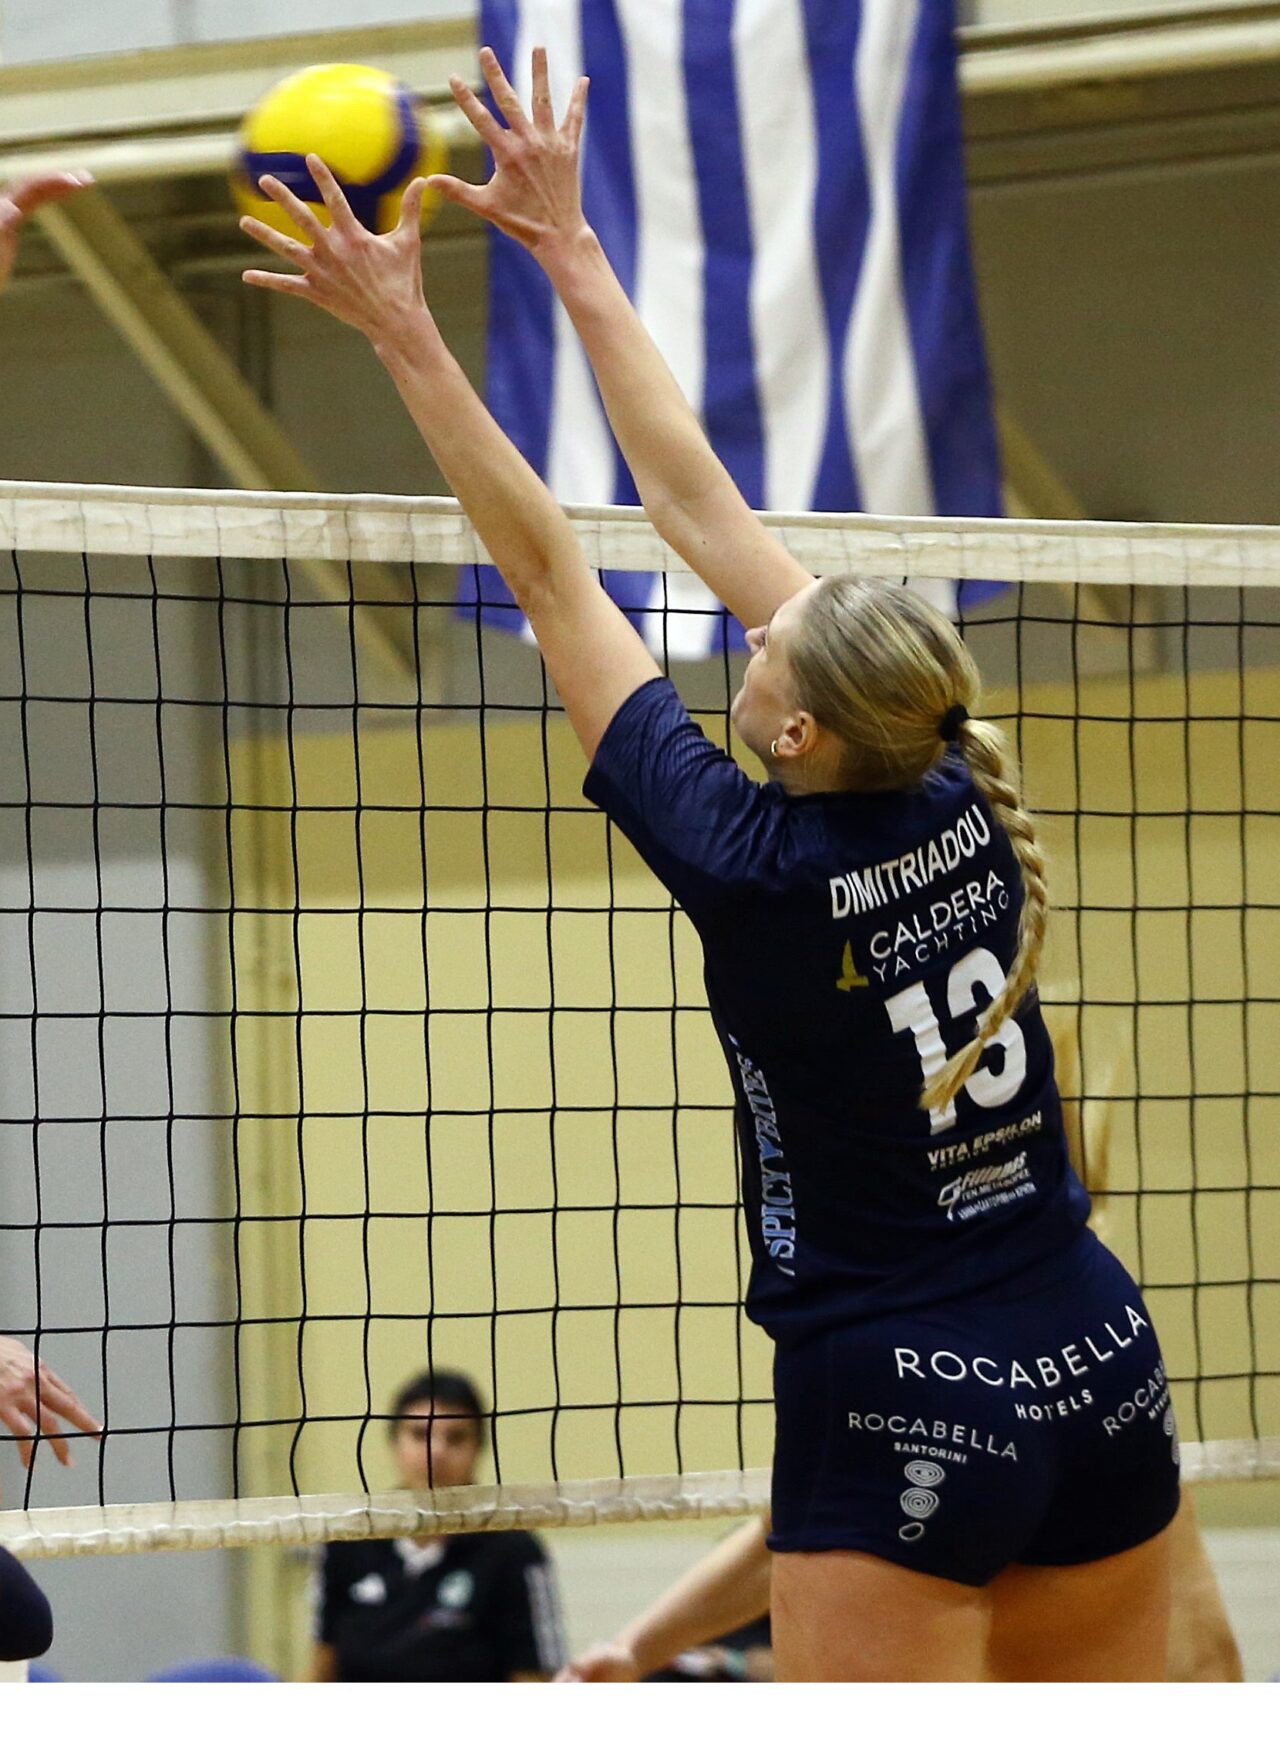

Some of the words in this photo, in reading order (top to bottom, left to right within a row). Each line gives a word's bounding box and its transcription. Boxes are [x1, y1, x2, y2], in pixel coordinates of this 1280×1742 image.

[829, 803, 991, 919] DIMITRIADOU
[870, 869, 1004, 959] CALDERA
[872, 889, 1009, 982] YACHTING
[884, 947, 1027, 1136] 13
[926, 1141, 969, 1166] VITA
[760, 1160, 797, 1259] SPICY
[893, 1304, 1148, 1390] ROCABELLA
[848, 1411, 1018, 1462] ROCABELLA
[1013, 1388, 1094, 1421] HOTELS
[892, 1441, 969, 1465] SANTORINI
